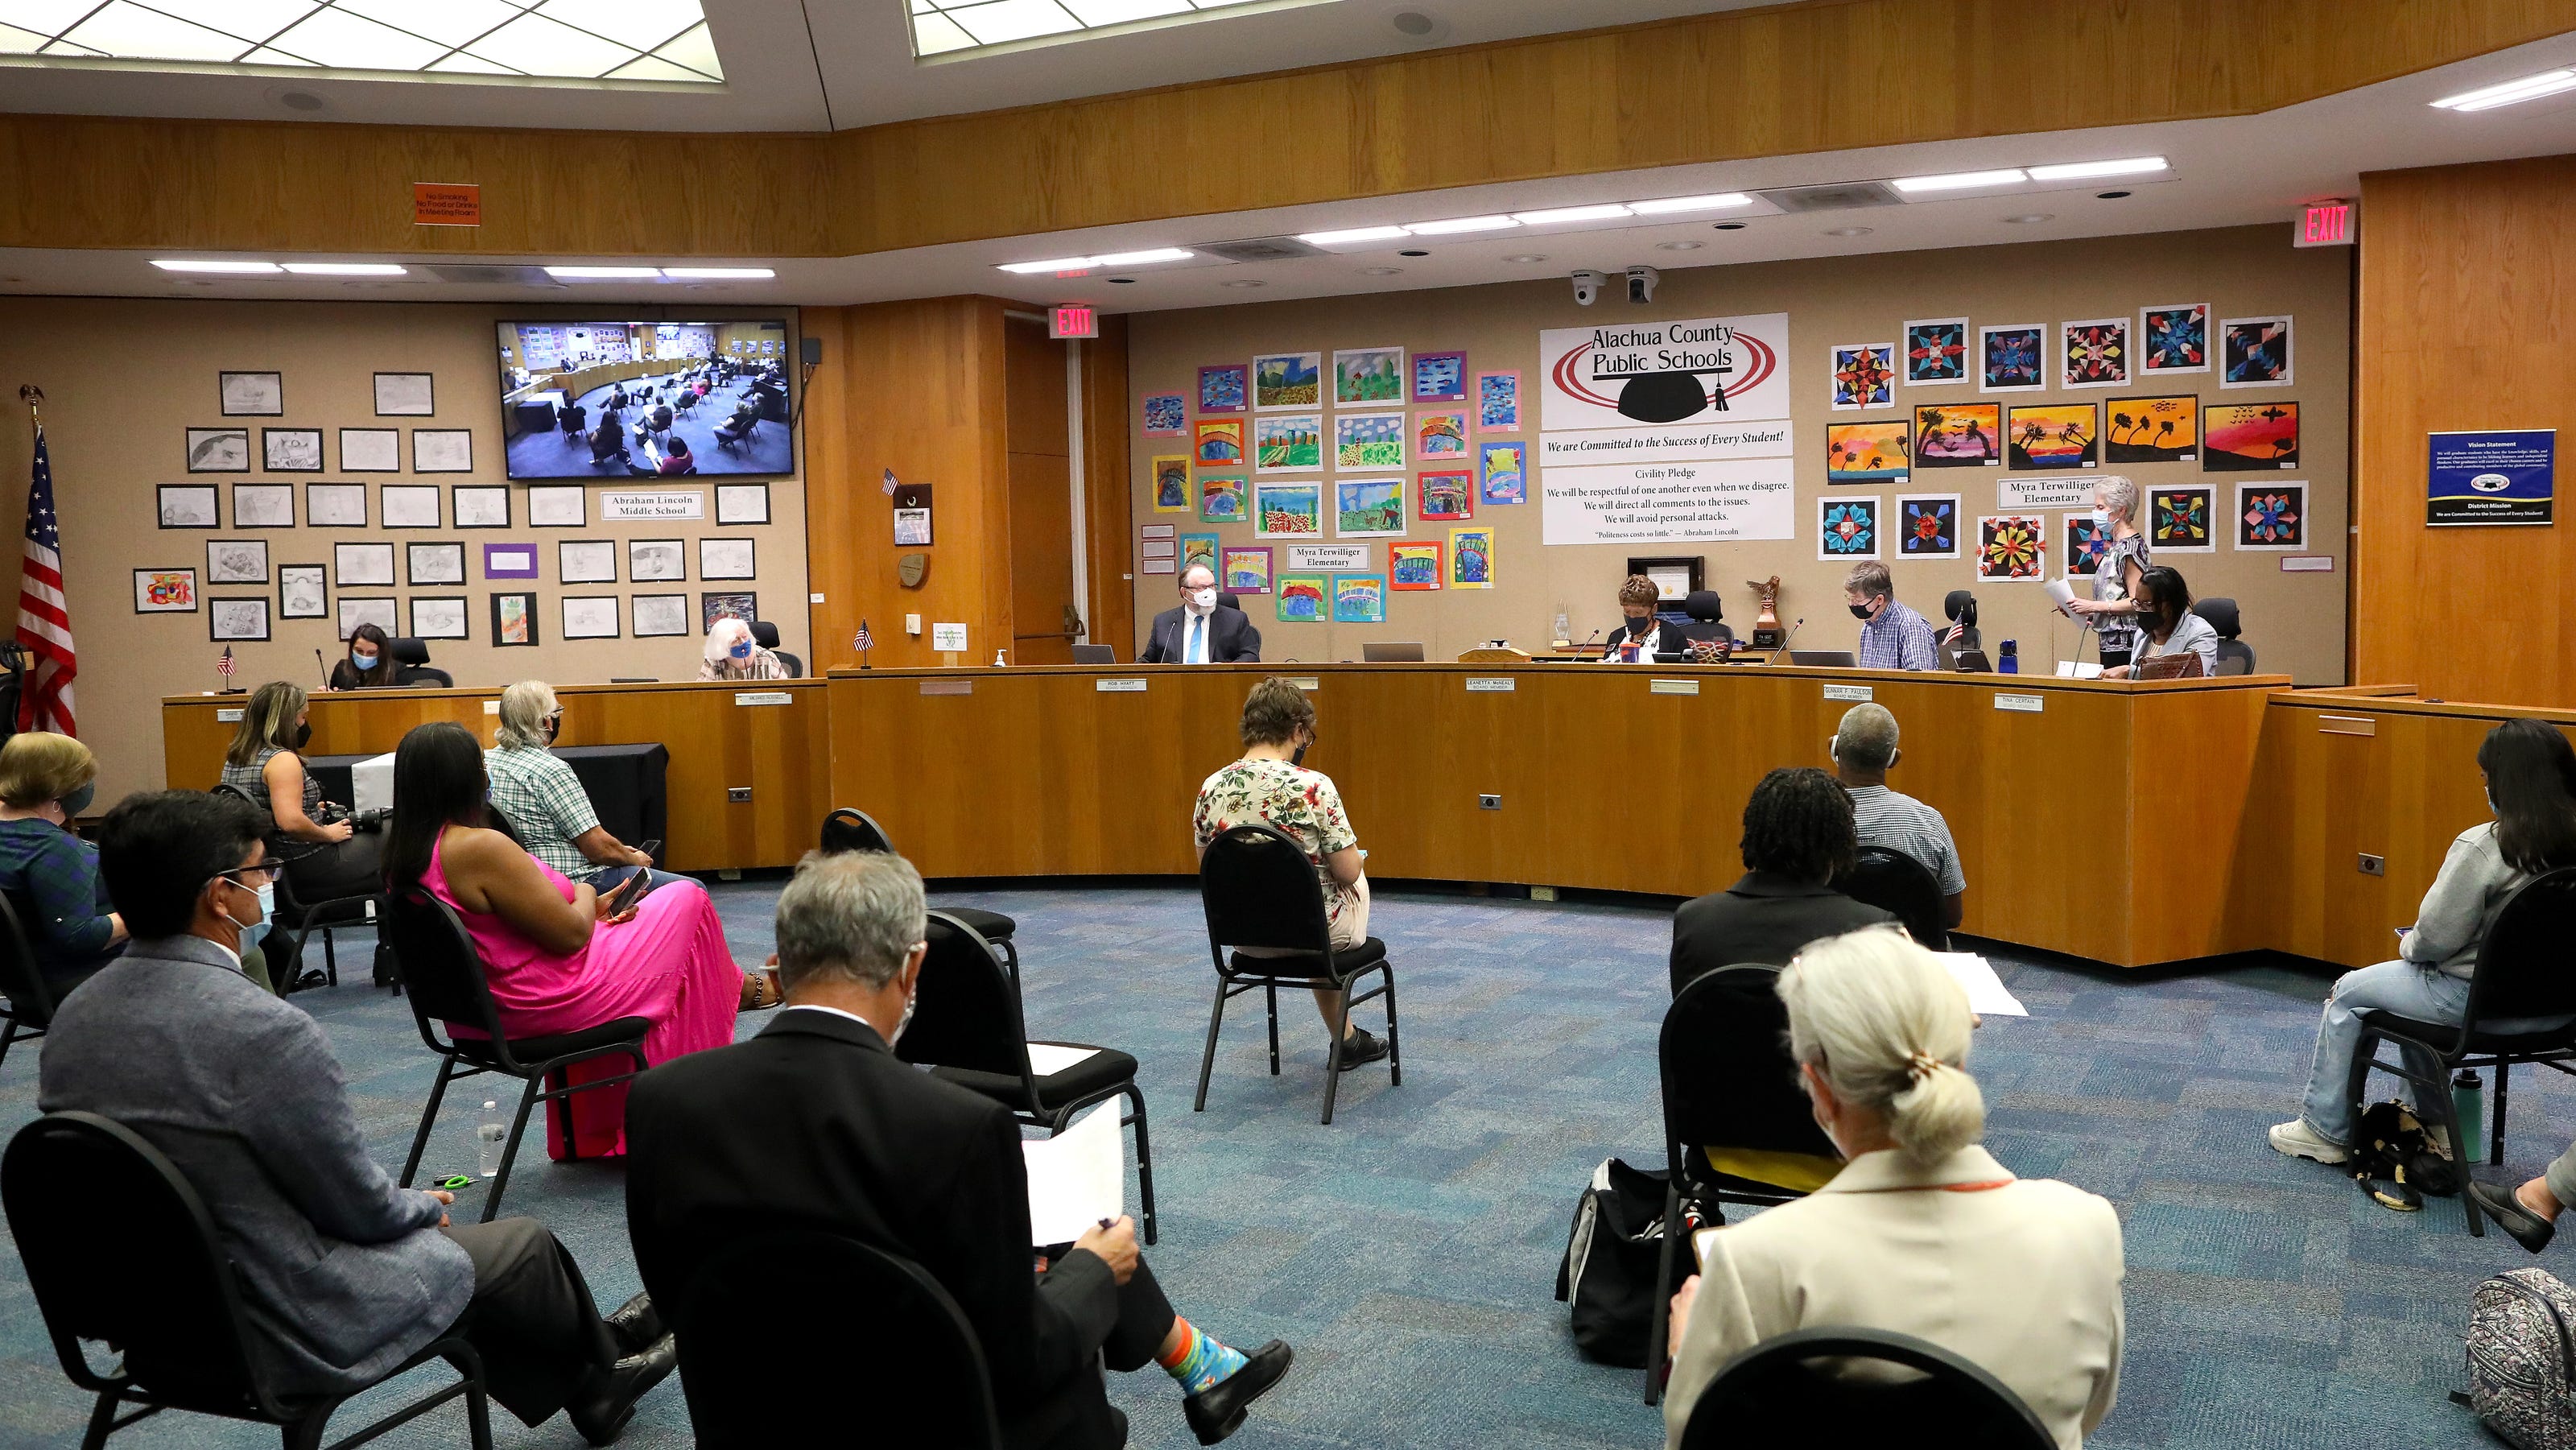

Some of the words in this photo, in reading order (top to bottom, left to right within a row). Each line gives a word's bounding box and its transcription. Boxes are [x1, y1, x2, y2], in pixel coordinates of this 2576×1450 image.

[438, 193, 468, 201] Smoking
[2306, 205, 2349, 243] EXIT
[1057, 308, 1092, 336] EXIT
[1591, 328, 1662, 349] Alachua
[1669, 324, 1734, 345] County
[1593, 353, 1649, 374] Public
[1657, 348, 1732, 370] Schools
[1547, 441, 1561, 452] We
[1563, 444, 1578, 452] are
[1580, 438, 1633, 450] Committed
[1634, 439, 1643, 448] to
[1645, 436, 1661, 448] the
[1662, 436, 1698, 447] Success
[1699, 434, 1711, 448] of
[1711, 433, 1740, 447] Every
[1741, 431, 1784, 443] Student!
[1635, 469, 1666, 480] Civility
[1668, 468, 1696, 479] Pledge
[1547, 489, 1560, 498] We
[1562, 488, 1576, 497] will
[1578, 488, 1587, 496] be
[1590, 485, 1629, 498] respectful
[1631, 485, 1641, 494] of
[1658, 484, 1690, 494] another
[1714, 482, 1736, 492] when
[1752, 481, 1790, 493] disagree.
[2010, 483, 2036, 493] Myra
[612, 497, 654, 505] Abraham
[658, 496, 692, 504] Lincoln
[1584, 502, 1597, 510] We
[1599, 501, 1613, 510] will
[1615, 500, 1639, 510] direct
[1641, 499, 1650, 508] all
[1653, 500, 1695, 508] comments
[1708, 498, 1722, 506] the
[1724, 497, 1750, 506] issues.
[2024, 494, 2081, 503] Elementary
[620, 507, 652, 515] Middle
[655, 506, 686, 515] School
[1604, 514, 1617, 524] We
[1619, 514, 1634, 523] will
[1636, 513, 1657, 523] avoid
[1660, 512, 1695, 524] personal
[1698, 511, 1729, 521] attacks.
[1296, 548, 1316, 557] Myra
[1319, 548, 1360, 557] Terwilliger
[1307, 558, 1350, 568] Elementary
